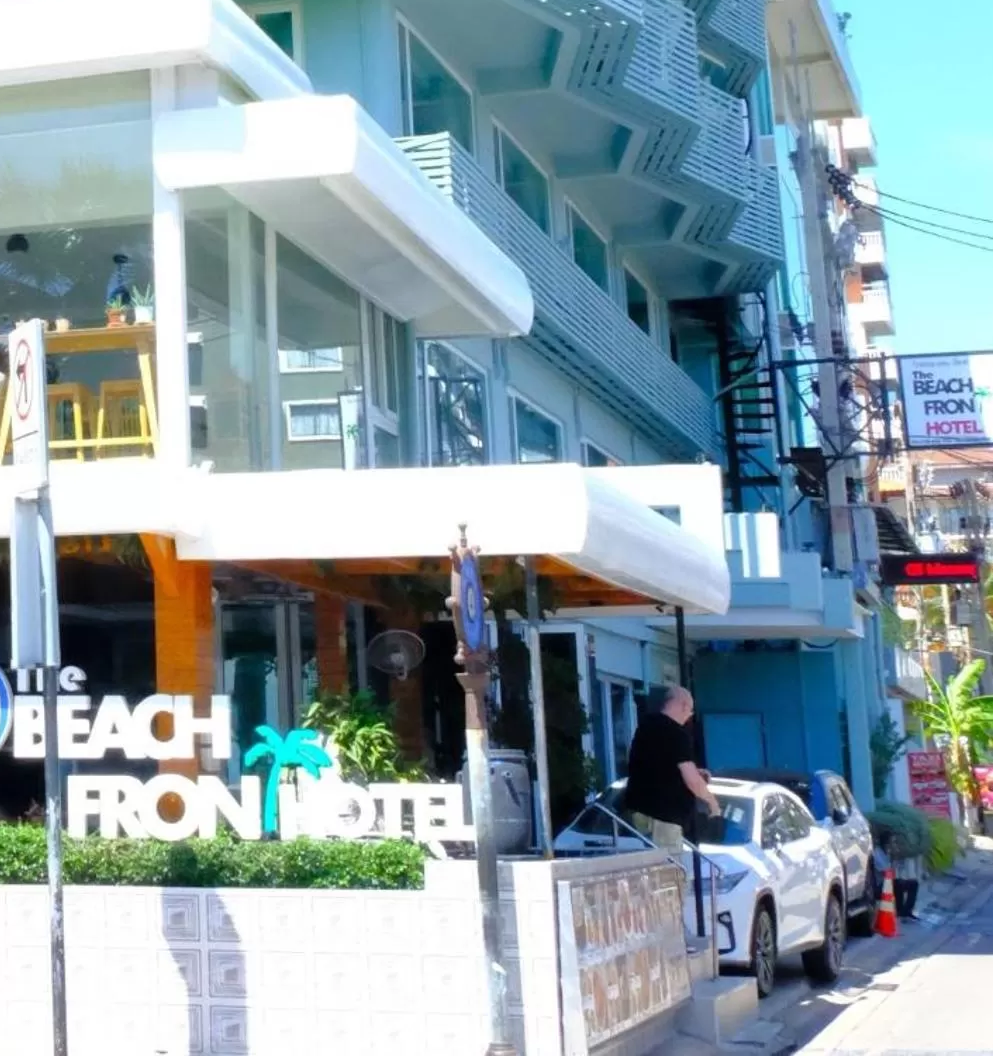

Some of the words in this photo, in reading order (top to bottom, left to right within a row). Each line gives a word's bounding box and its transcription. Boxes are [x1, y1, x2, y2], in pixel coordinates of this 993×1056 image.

[912, 371, 933, 379] The
[913, 377, 973, 395] BEACH
[926, 420, 984, 435] HOTEL
[13, 694, 232, 759] BEACH
[279, 782, 477, 842] HOTEL
